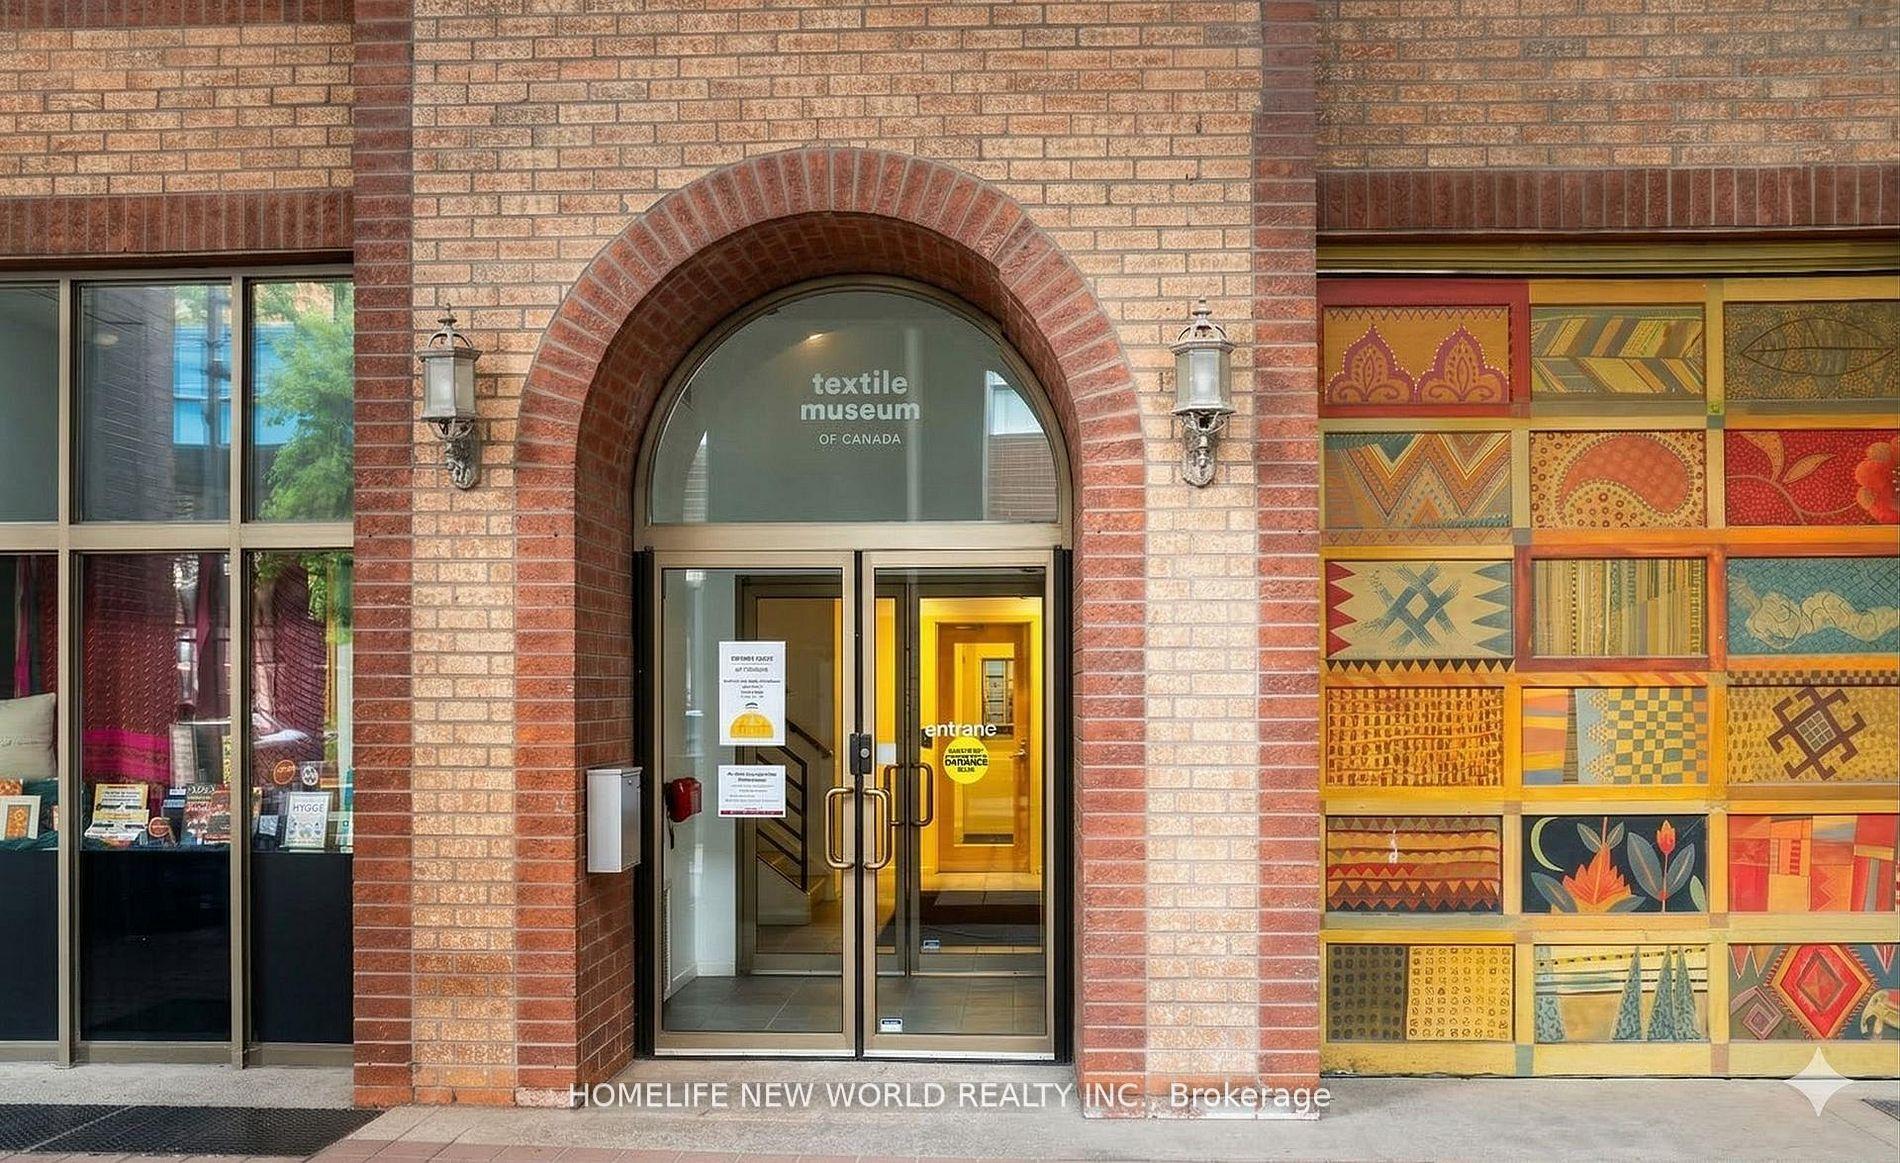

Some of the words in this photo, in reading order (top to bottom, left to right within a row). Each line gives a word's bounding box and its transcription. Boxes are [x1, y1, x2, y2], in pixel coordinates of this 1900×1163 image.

[812, 369, 908, 395] textile
[800, 402, 920, 421] museum
[819, 433, 837, 445] OF
[842, 433, 902, 445] CANADA
[924, 721, 997, 738] entrane
[293, 803, 324, 813] HYGGE
